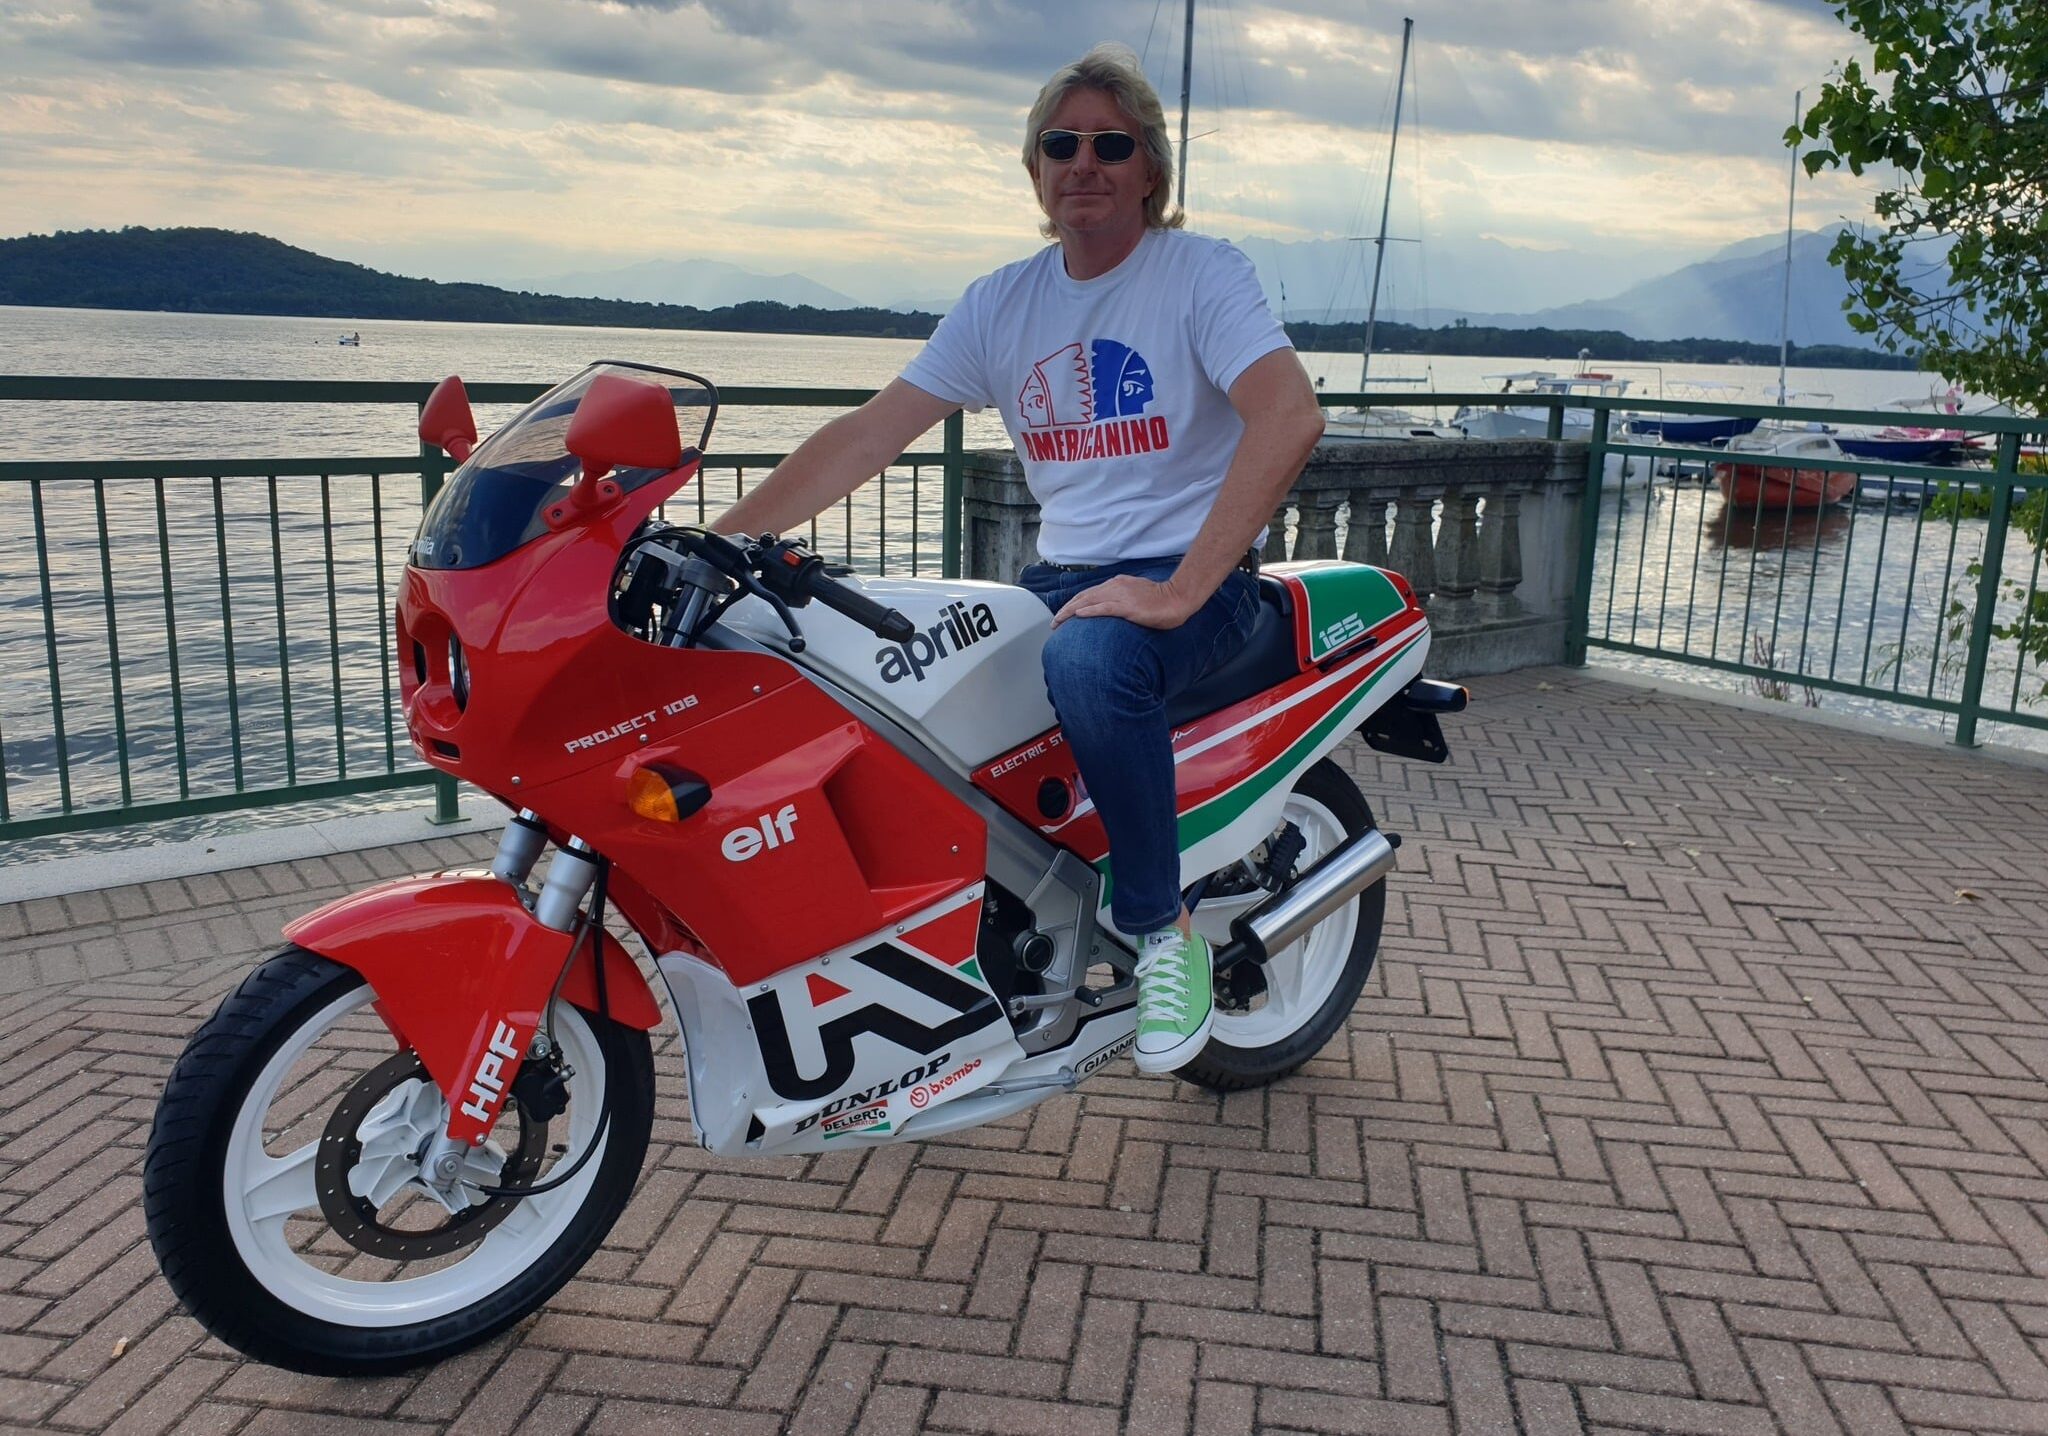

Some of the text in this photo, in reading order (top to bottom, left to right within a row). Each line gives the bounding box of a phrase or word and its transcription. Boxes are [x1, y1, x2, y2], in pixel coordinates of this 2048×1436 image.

[1021, 416, 1169, 462] AMERICANINO
[876, 601, 998, 683] aprilia
[1319, 612, 1364, 649] 125
[564, 694, 699, 753] PROJECT 108
[990, 732, 1064, 778] ELECTRIC ST
[721, 804, 798, 862] elf
[461, 1020, 518, 1123] HPF
[929, 1059, 982, 1095] brembo
[1084, 1036, 1136, 1073] GIANNE
[792, 1053, 950, 1135] DUNLOP
